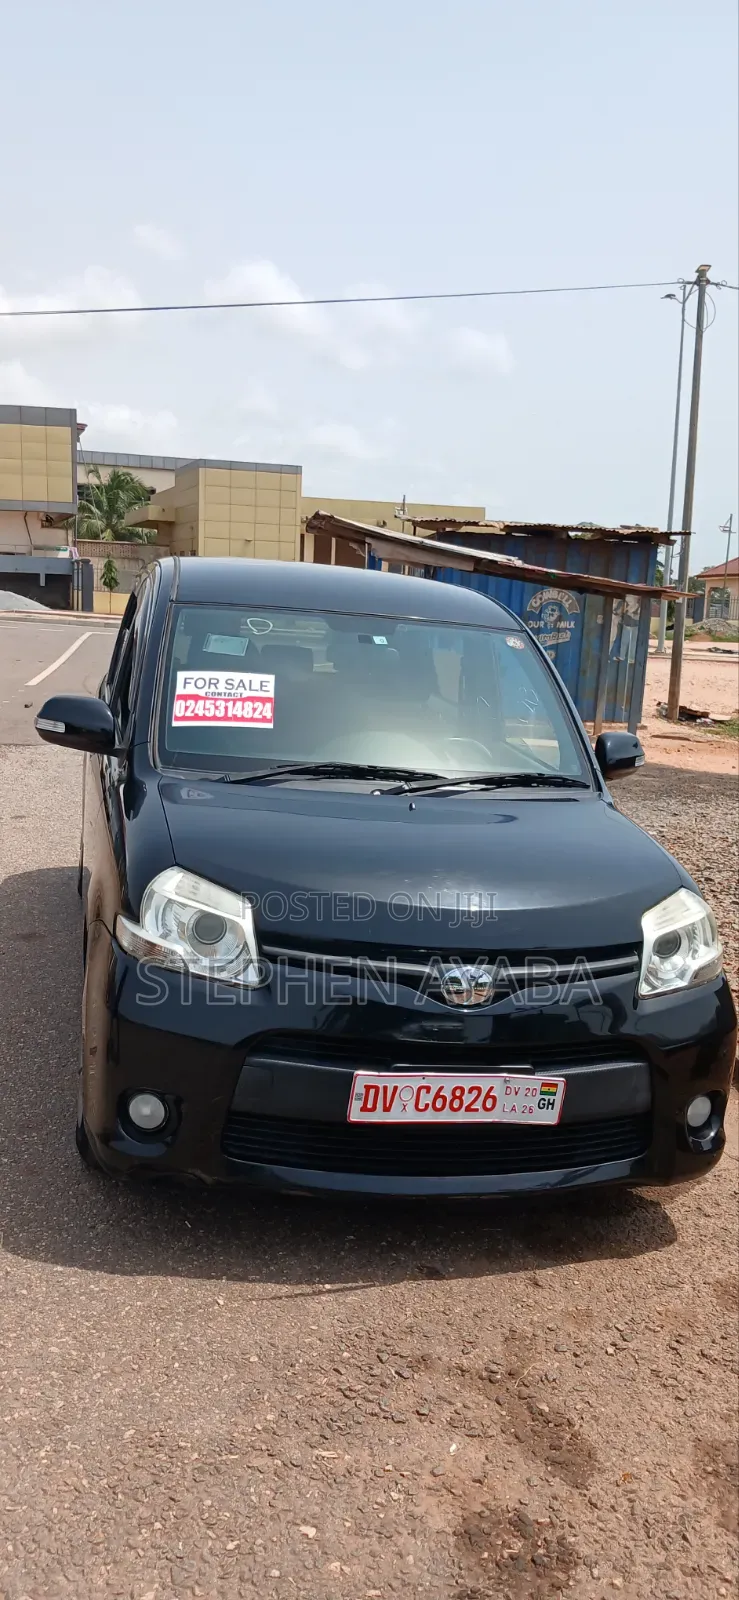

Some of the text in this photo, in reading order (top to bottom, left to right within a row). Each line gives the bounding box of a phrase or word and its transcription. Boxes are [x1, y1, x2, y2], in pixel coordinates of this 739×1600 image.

[556, 620, 576, 629] MILK
[183, 677, 270, 692] FOR SALE
[175, 699, 272, 719] 0245314824
[505, 1085, 537, 1098] DV 20
[360, 1084, 498, 1113] DV C6826
[537, 1097, 556, 1110] GH
[502, 1103, 534, 1114] LA 26
